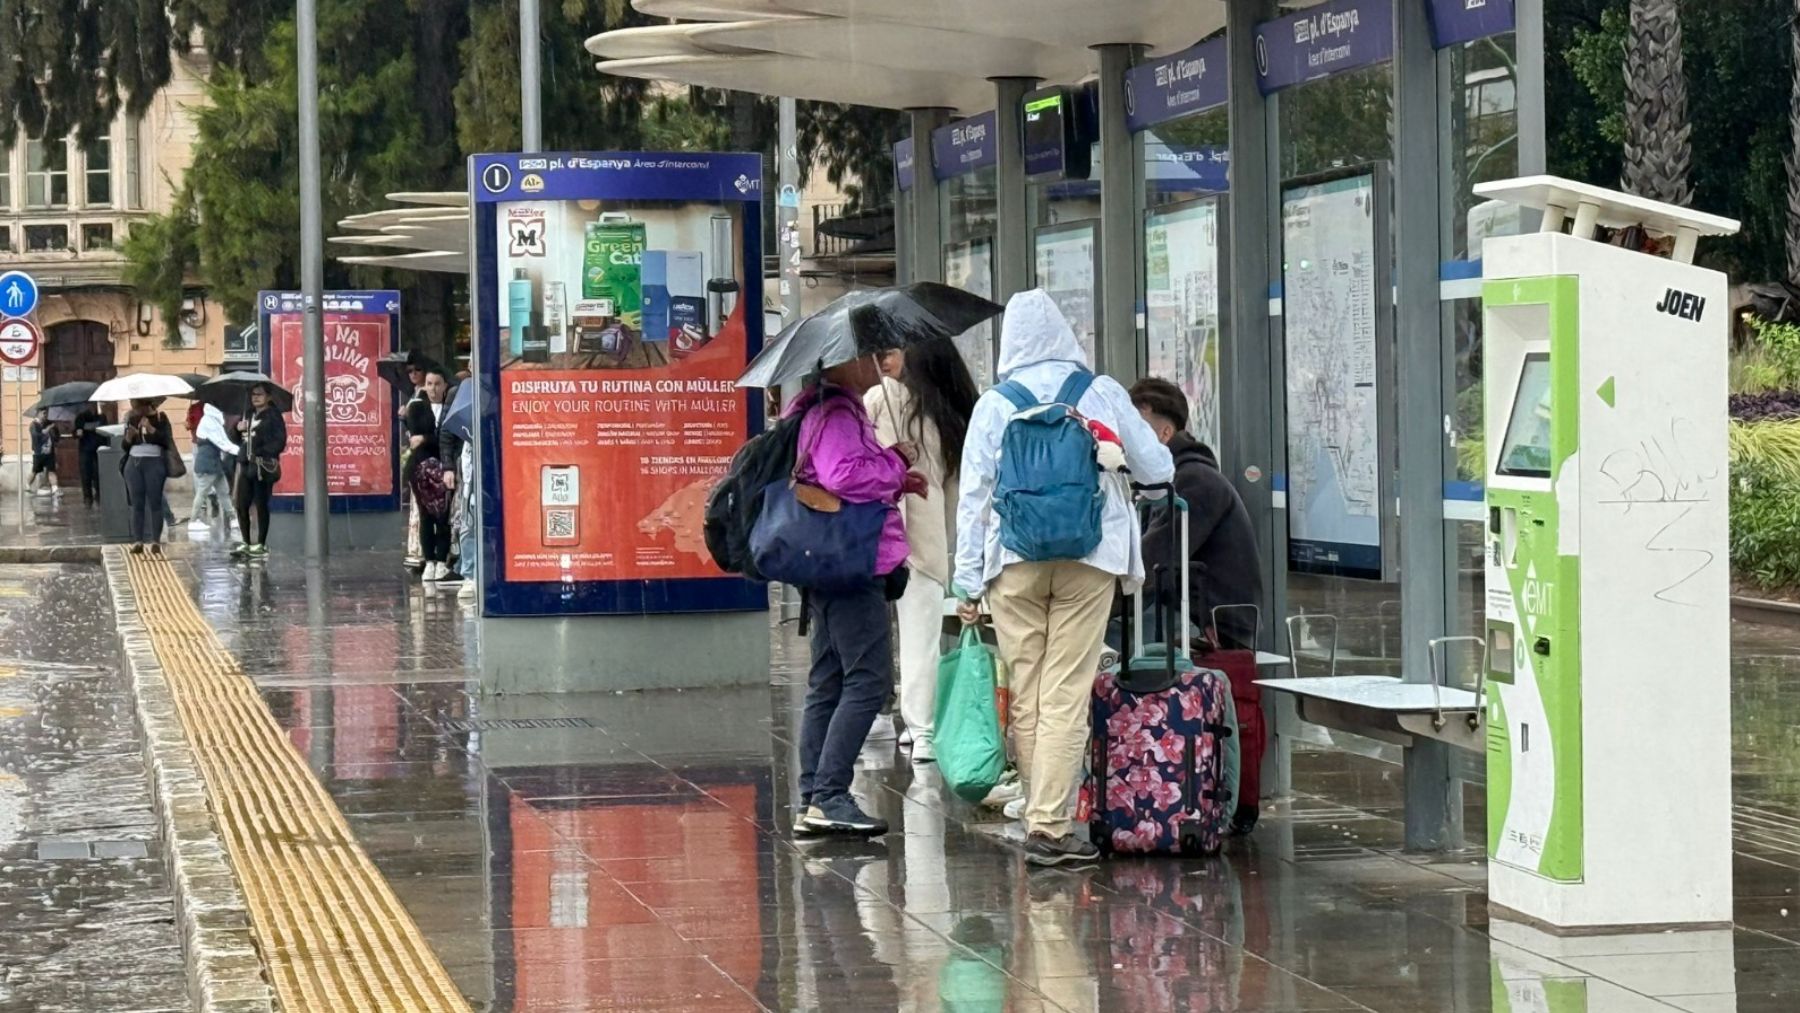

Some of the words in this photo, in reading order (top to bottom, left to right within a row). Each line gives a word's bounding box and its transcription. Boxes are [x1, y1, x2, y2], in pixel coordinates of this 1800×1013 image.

[549, 158, 564, 171] pl.
[567, 157, 631, 171] d'Espanya
[516, 229, 537, 246] M
[587, 240, 642, 253] Green
[609, 250, 642, 265] Cat
[1656, 288, 1706, 322] JOEN
[336, 324, 359, 346] NA
[511, 380, 576, 394] DISFRUTA
[579, 381, 598, 393] TU
[602, 380, 653, 393] RUTINA
[656, 380, 682, 393] CON
[686, 377, 735, 393] MÜLLER
[512, 400, 550, 415] ENJOY
[554, 400, 590, 413] YOUR
[595, 400, 651, 413] ROUTINE
[655, 400, 687, 412] WITH
